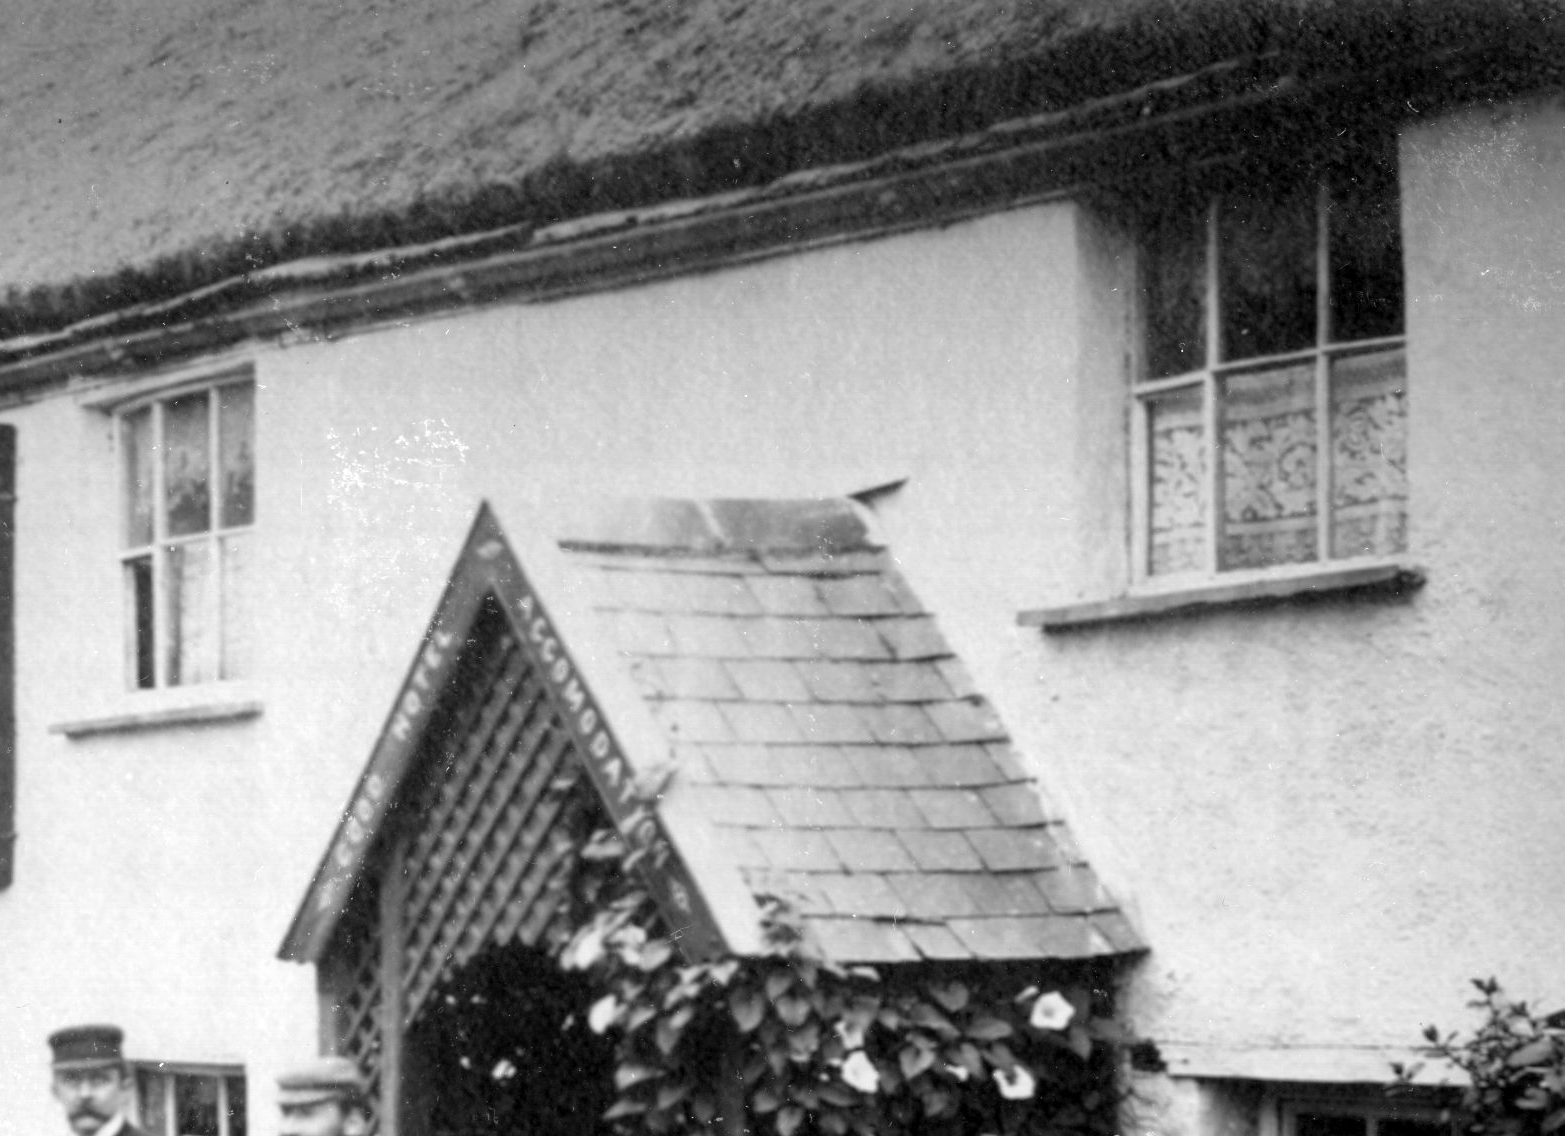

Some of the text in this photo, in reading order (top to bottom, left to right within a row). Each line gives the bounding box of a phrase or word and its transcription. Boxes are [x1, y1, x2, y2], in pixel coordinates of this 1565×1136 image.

[334, 630, 453, 868] GOOD HOTEL
[518, 594, 670, 869] ACCOMODATON
